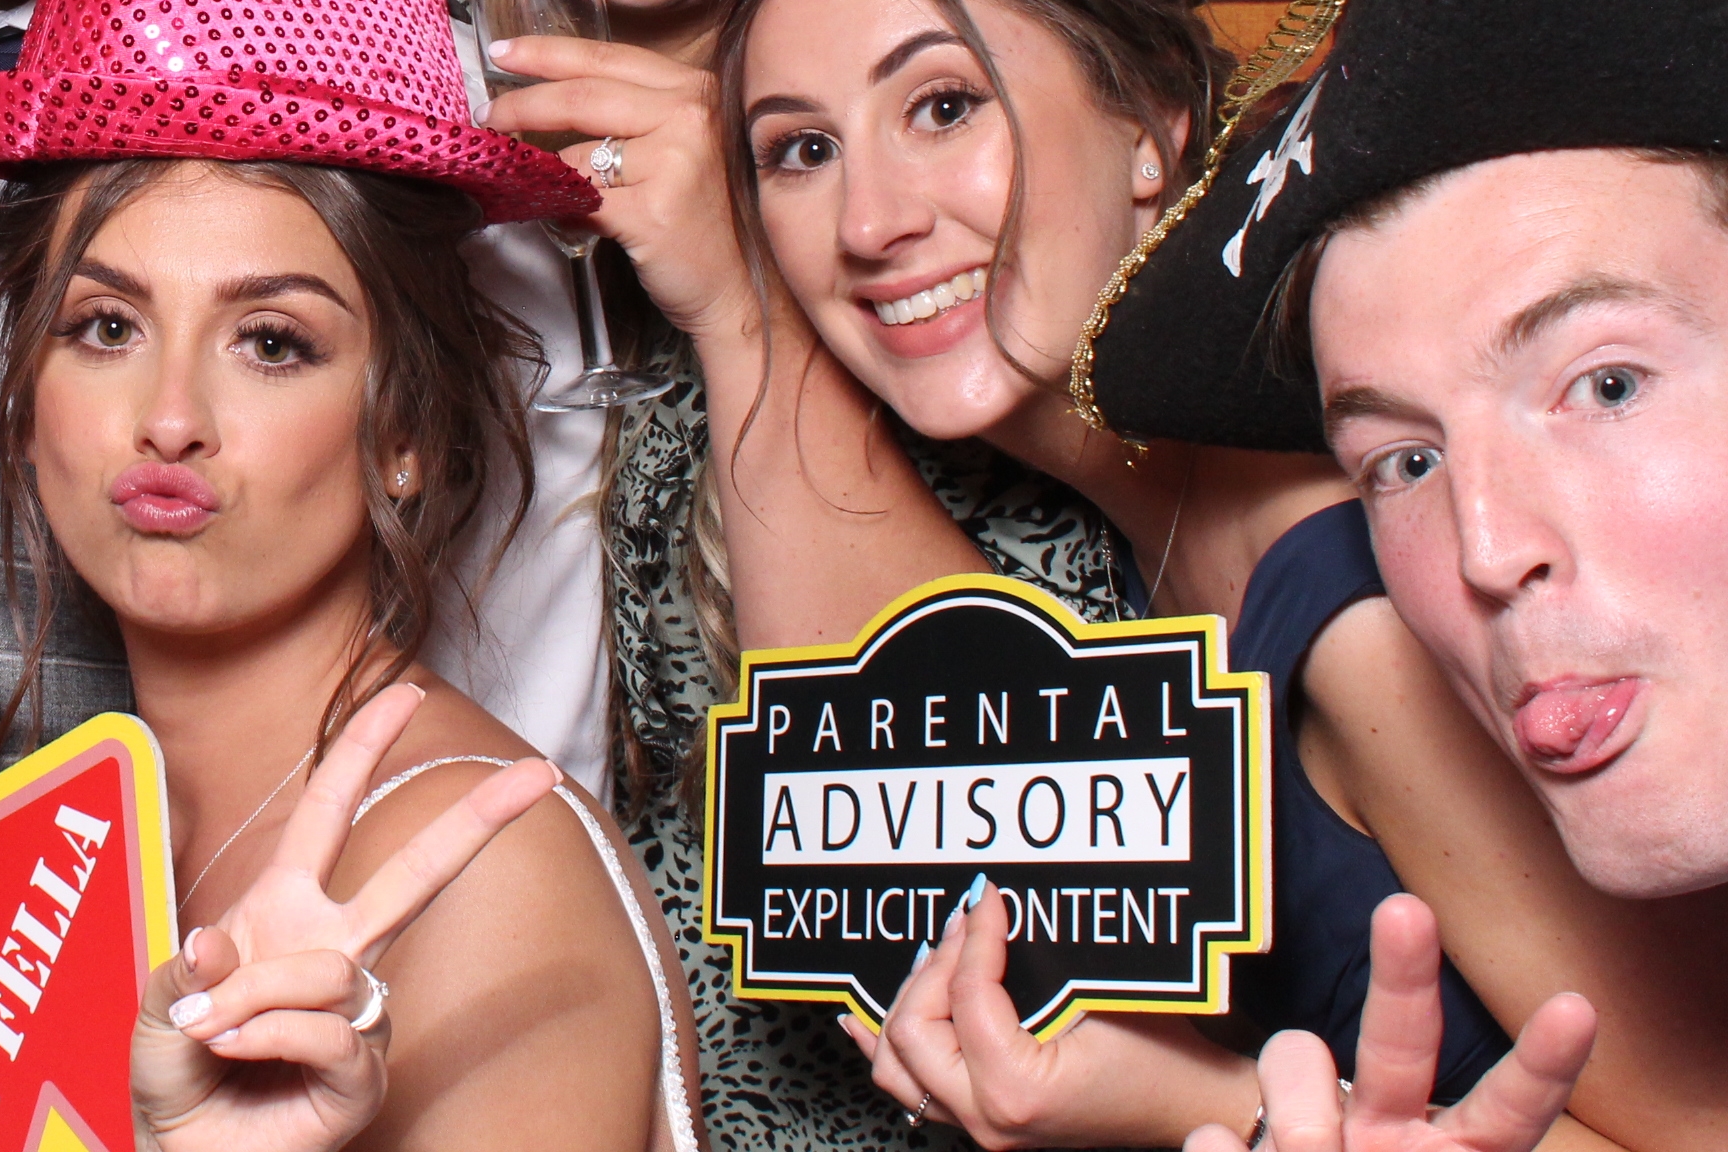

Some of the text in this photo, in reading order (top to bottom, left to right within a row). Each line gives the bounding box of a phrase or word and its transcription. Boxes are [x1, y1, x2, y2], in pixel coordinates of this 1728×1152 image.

[768, 681, 1187, 754] PARENTAL
[764, 771, 1187, 852] ADVISORY
[763, 887, 1190, 944] EXPLICIT ONTENT
